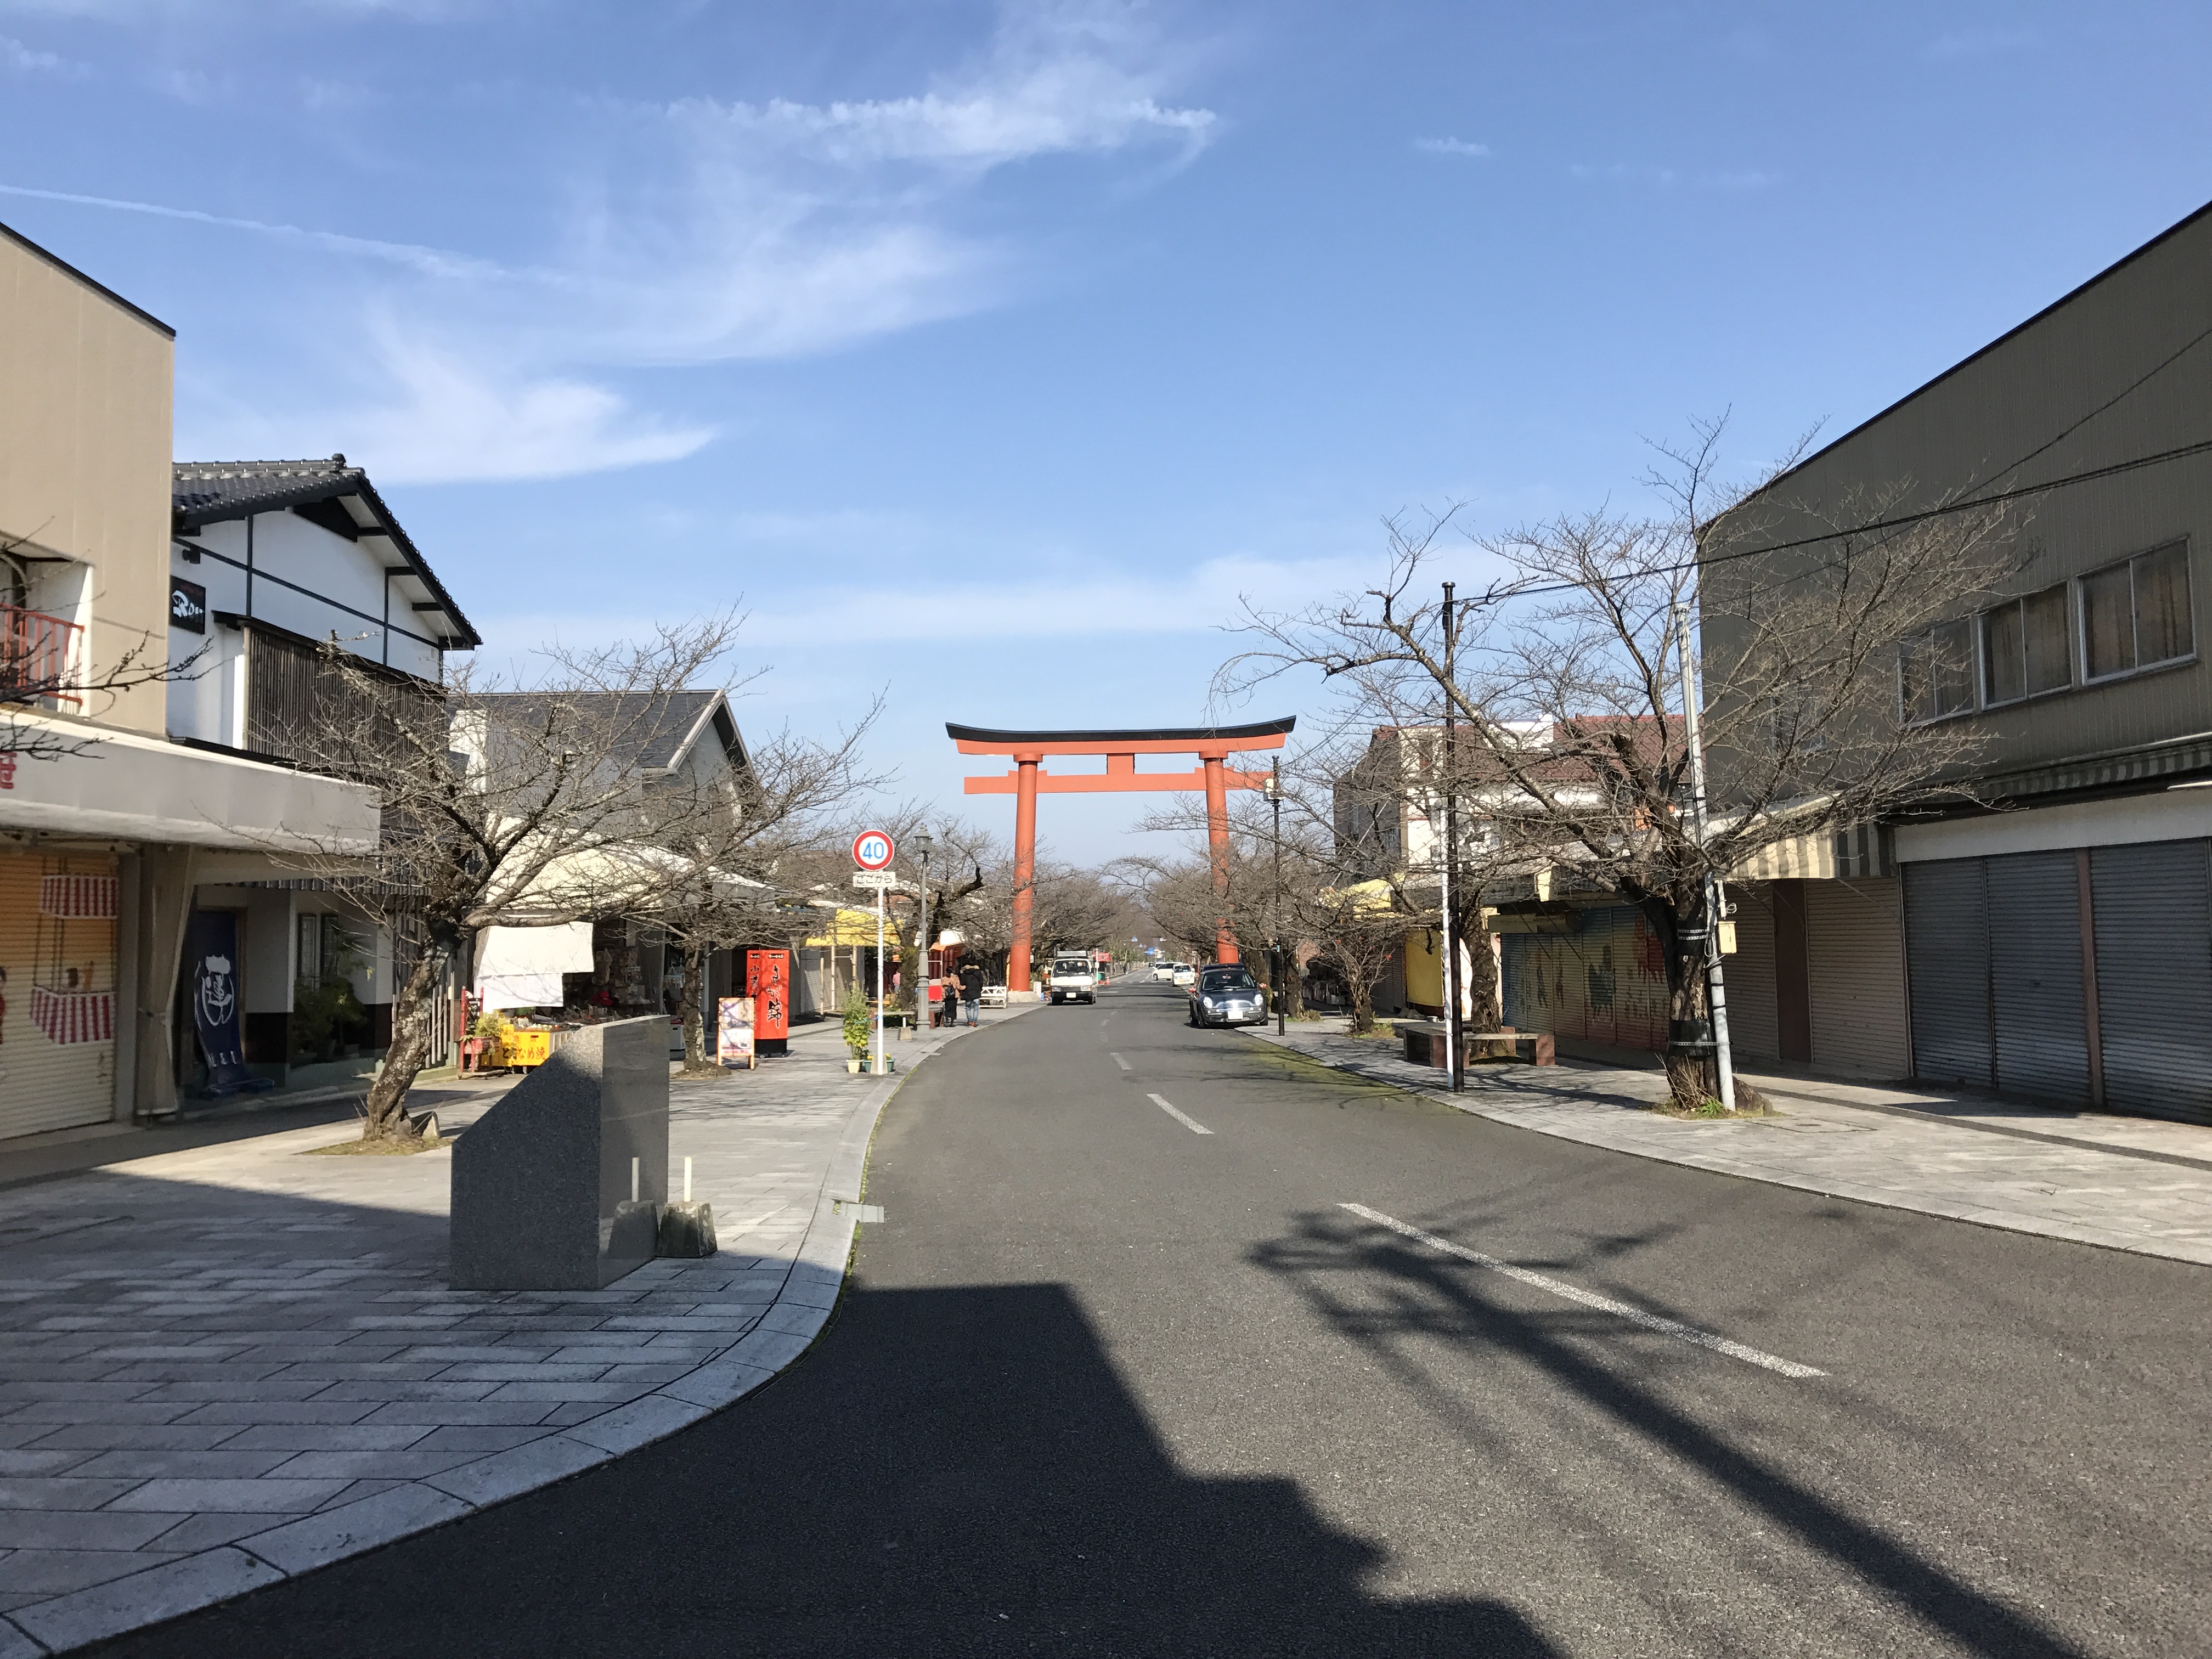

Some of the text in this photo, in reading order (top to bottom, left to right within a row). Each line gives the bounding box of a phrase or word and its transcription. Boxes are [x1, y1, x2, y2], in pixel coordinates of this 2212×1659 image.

[862, 842, 884, 859] 40
[856, 875, 893, 884] ここから
[766, 964, 783, 1029] さが錦
